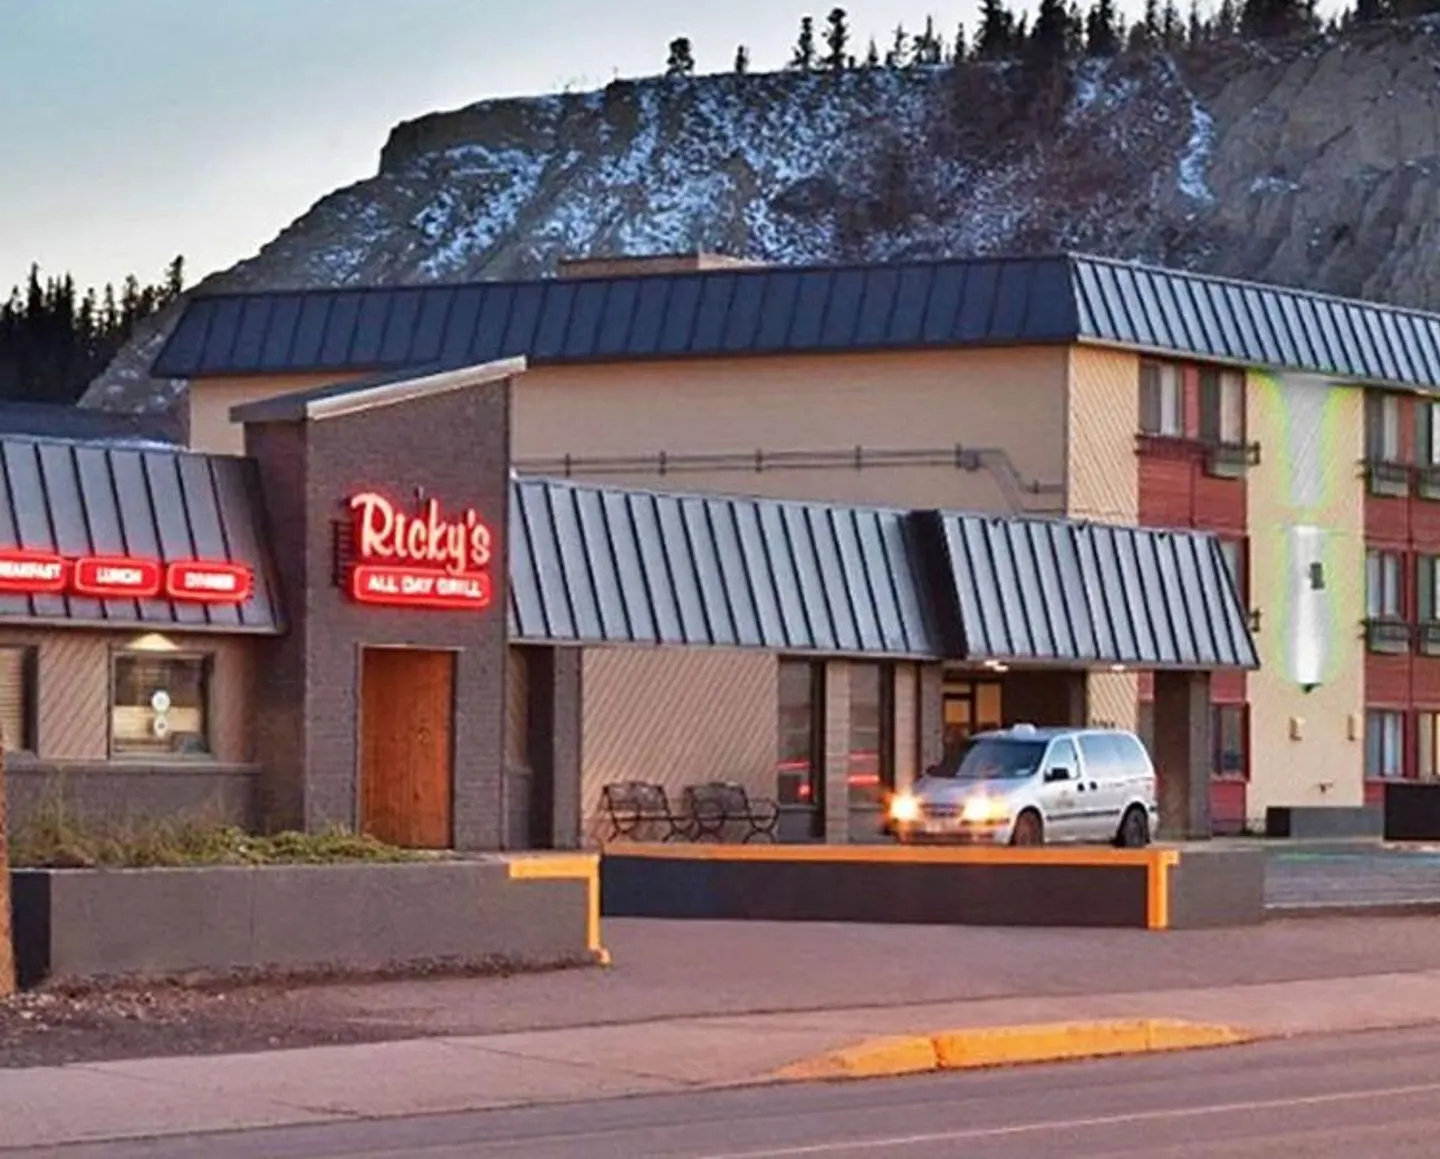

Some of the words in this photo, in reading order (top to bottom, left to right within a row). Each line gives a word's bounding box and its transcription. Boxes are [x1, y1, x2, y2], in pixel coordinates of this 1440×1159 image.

[351, 492, 491, 575] Ricky's
[0, 561, 62, 580] REAKFAST
[96, 567, 143, 585] LUNCH
[368, 575, 399, 593] ALL
[401, 576, 434, 594] DAY
[436, 578, 483, 598] GRILL
